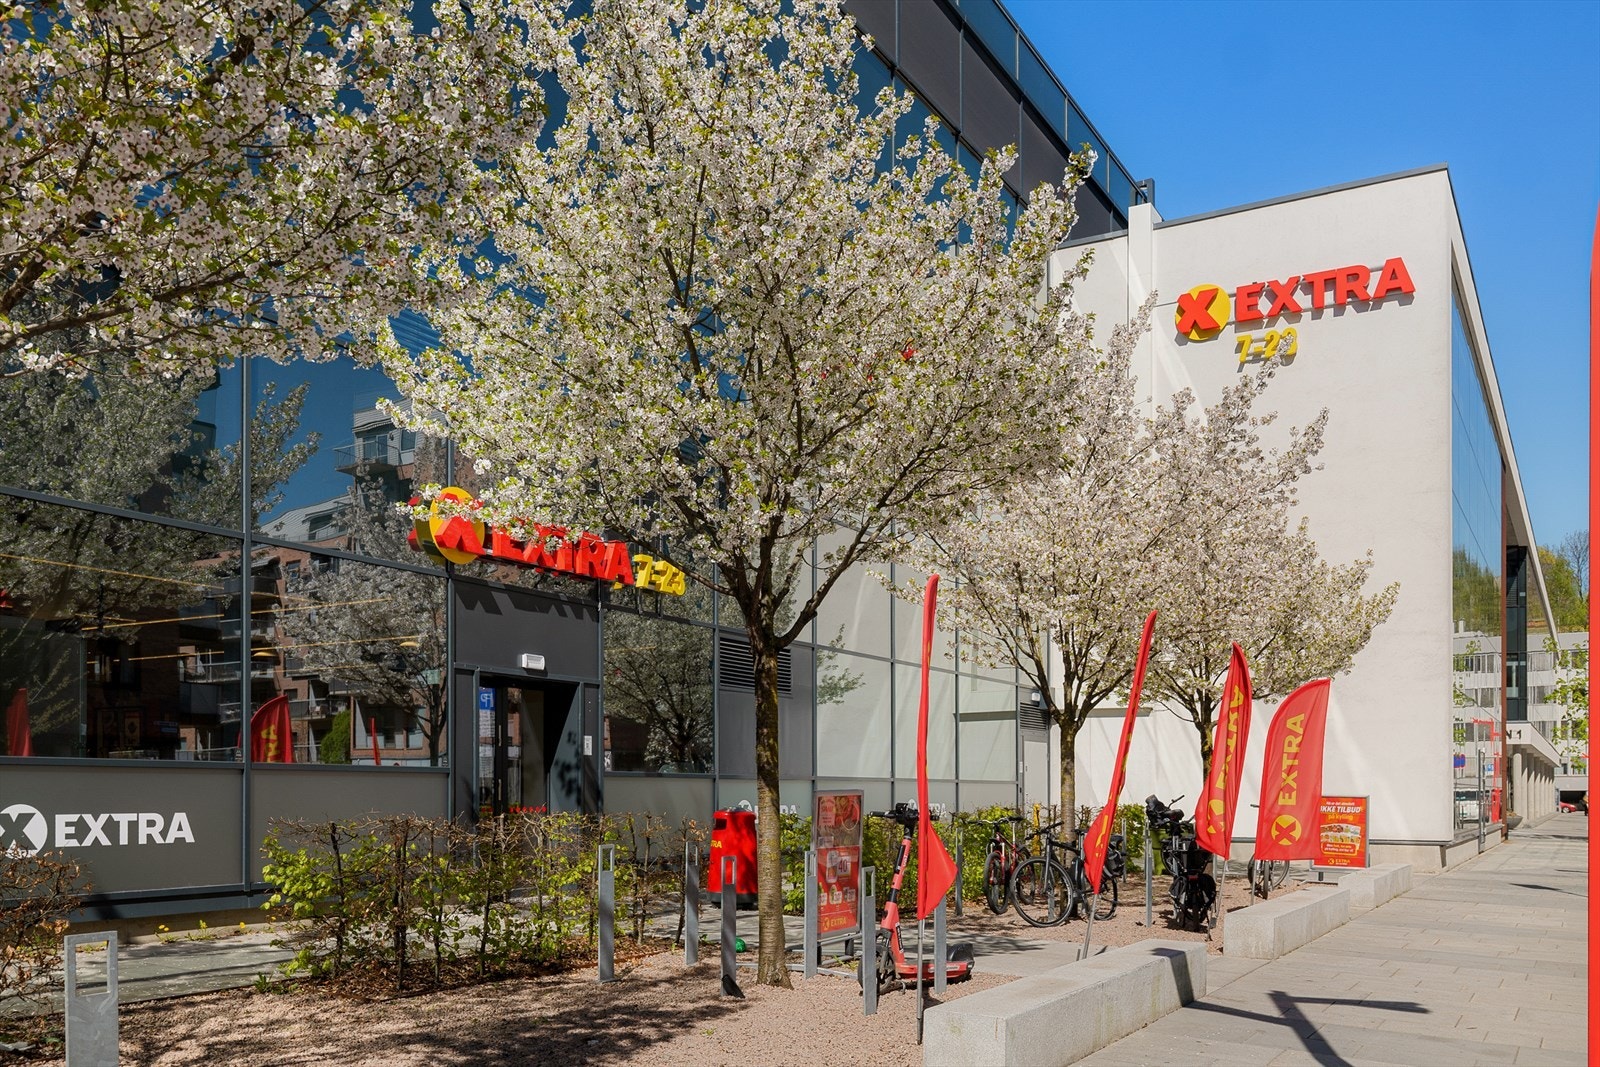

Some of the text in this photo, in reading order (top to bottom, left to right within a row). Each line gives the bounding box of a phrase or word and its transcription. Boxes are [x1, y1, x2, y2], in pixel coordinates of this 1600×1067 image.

[1234, 256, 1416, 323] EXTRA
[491, 519, 635, 586] EXTRA
[1277, 713, 1305, 806] EXTRA
[54, 811, 196, 848] EXTRA
[1320, 805, 1336, 813] IKKE
